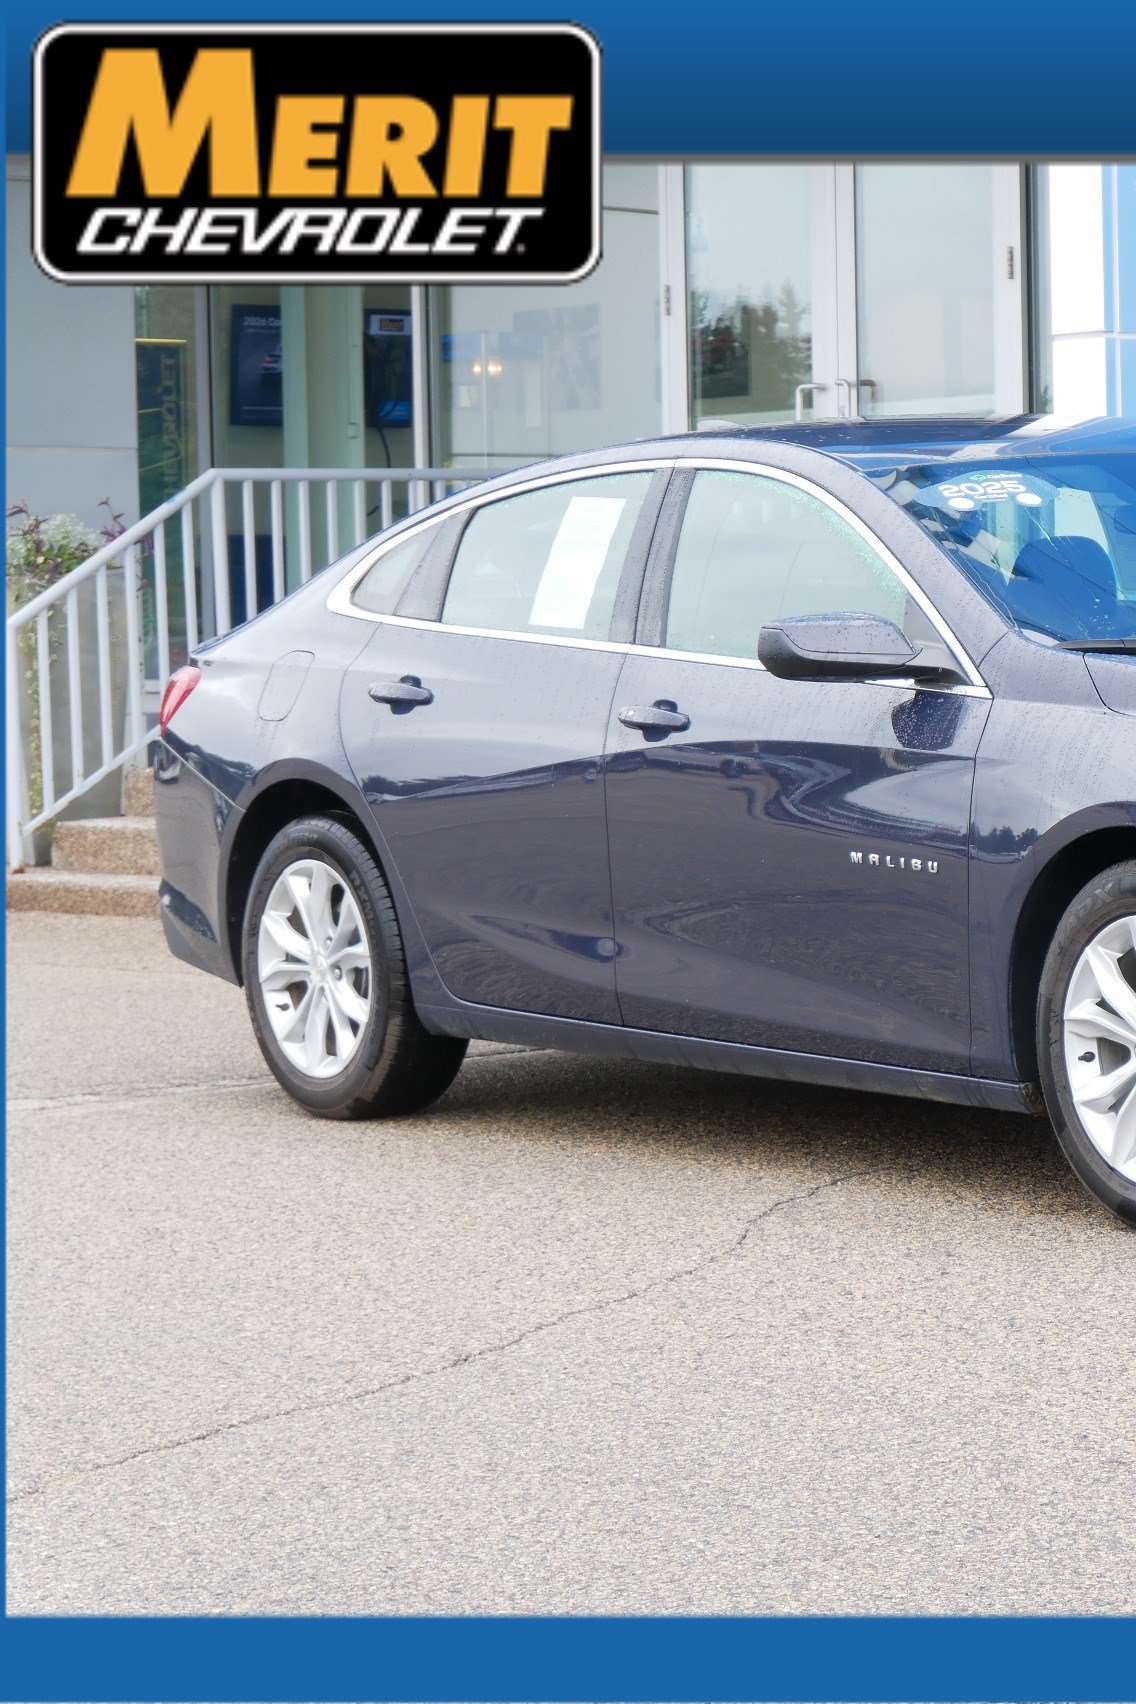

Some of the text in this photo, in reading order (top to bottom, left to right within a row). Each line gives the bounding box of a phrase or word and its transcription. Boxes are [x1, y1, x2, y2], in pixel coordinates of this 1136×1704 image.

[160, 353, 177, 494] HEVROLET
[938, 480, 1027, 497] 2025
[849, 851, 939, 874] MALIBU
